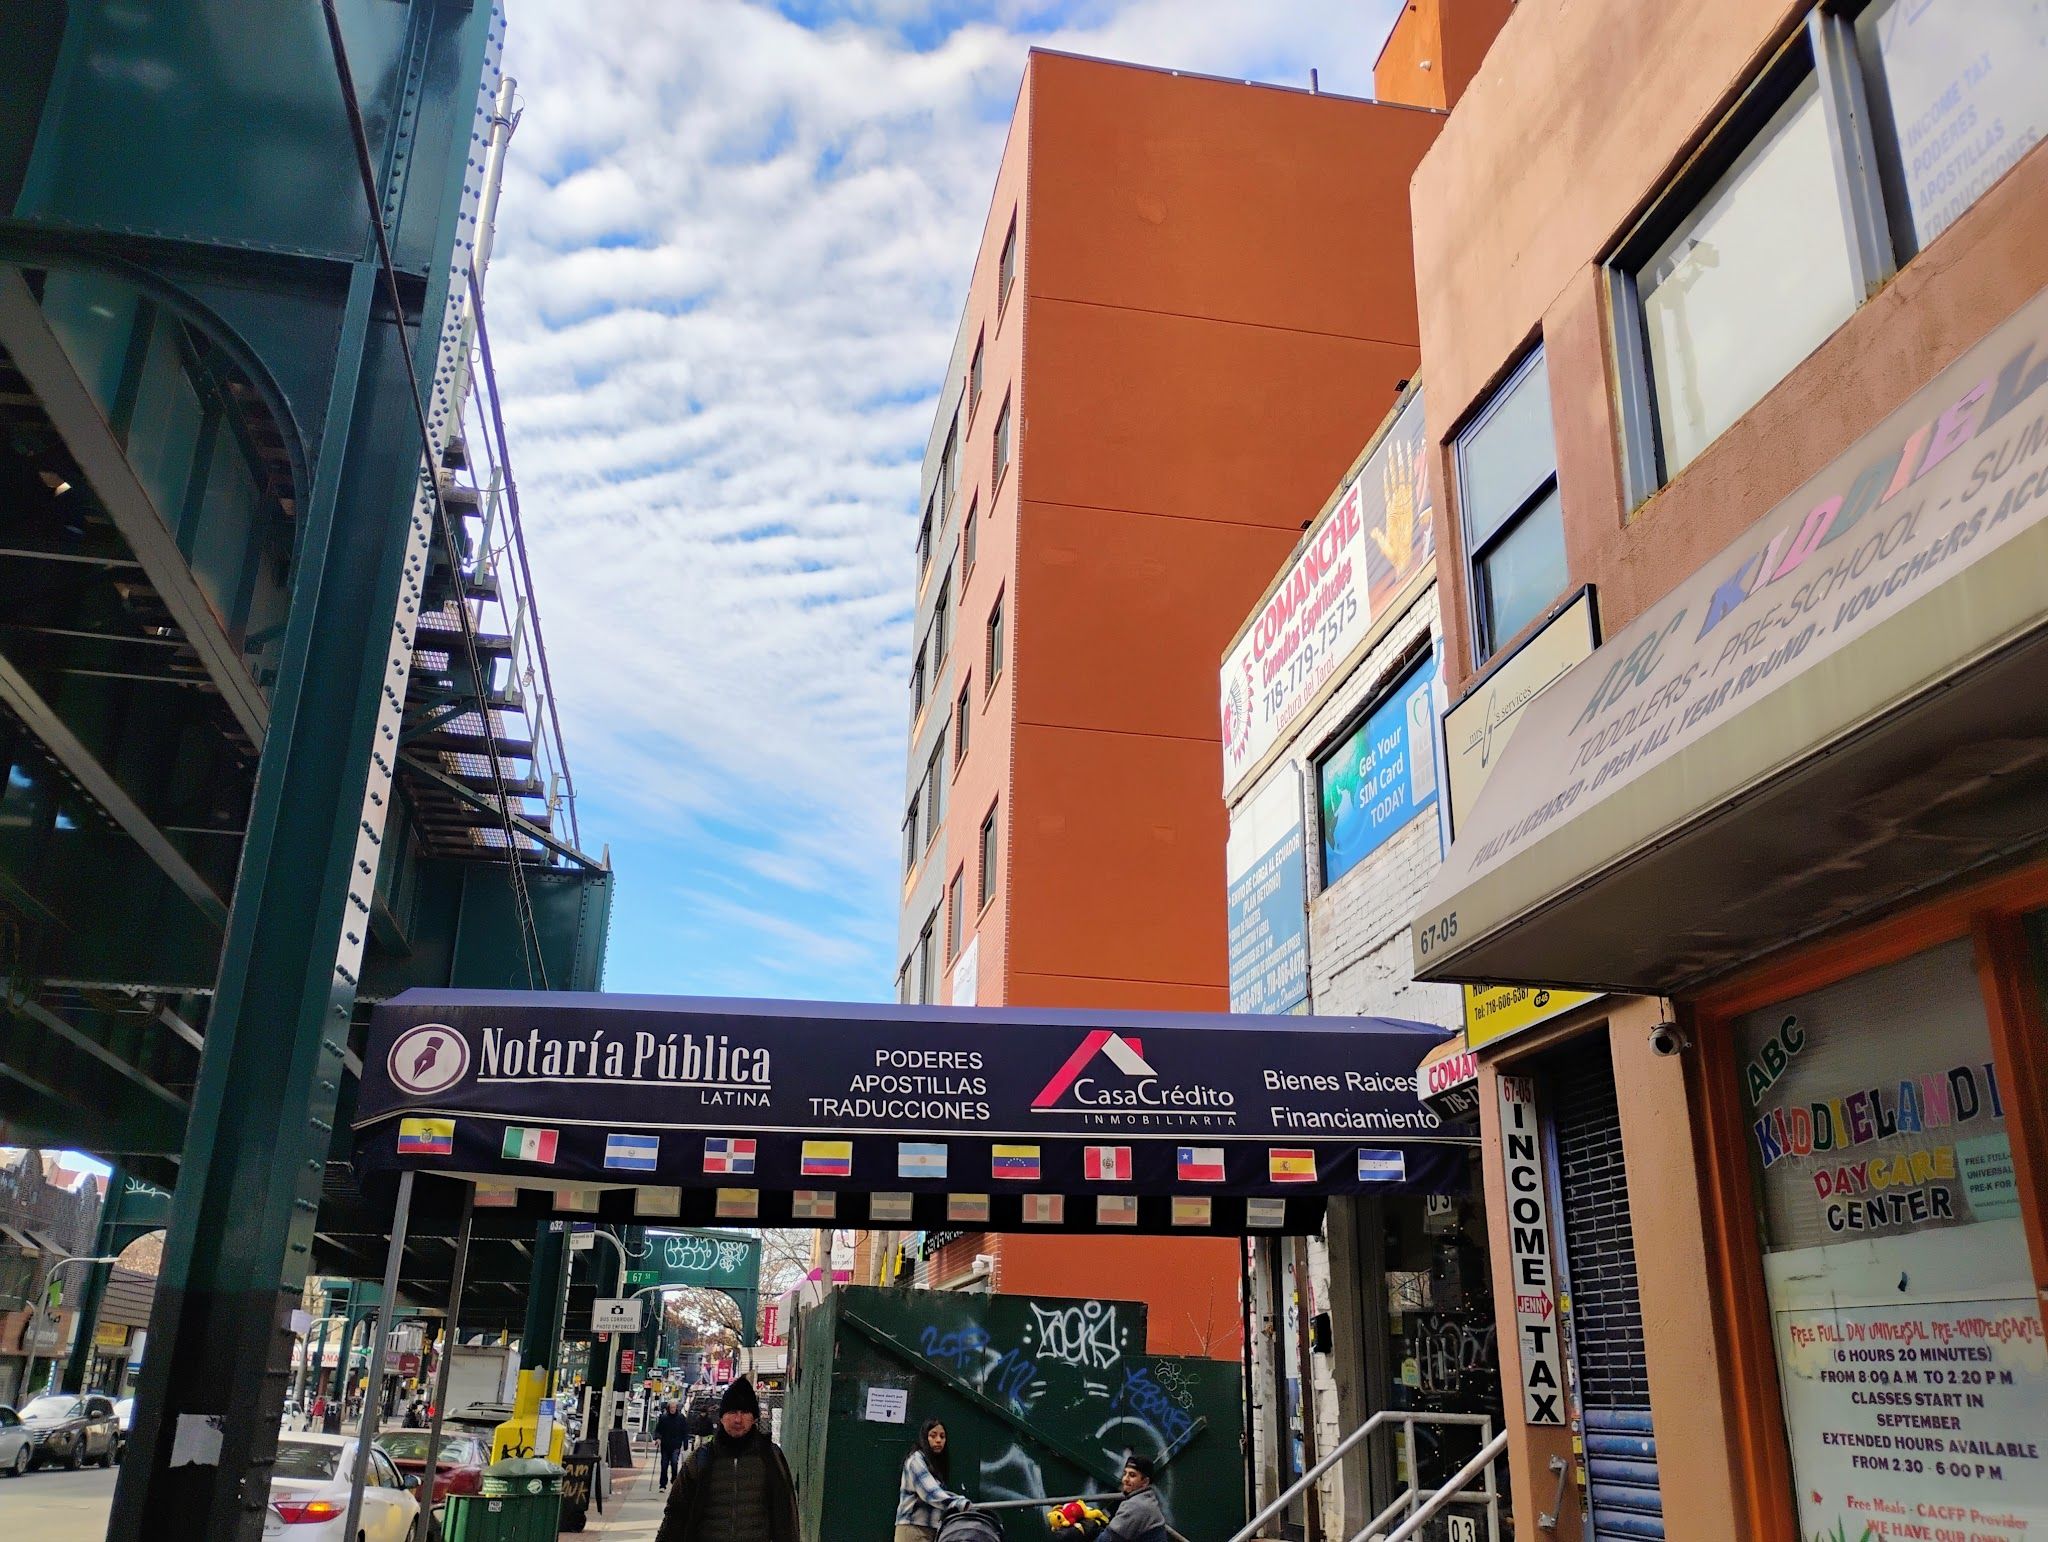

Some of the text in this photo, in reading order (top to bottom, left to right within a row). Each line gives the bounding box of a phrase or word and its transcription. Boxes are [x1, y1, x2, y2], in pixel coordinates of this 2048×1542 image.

[1907, 54, 1992, 149] INCOME TAX
[1913, 103, 1977, 179] PODERES
[1919, 117, 2006, 212] APOSTILLAS
[1253, 486, 1360, 663] COMANCHE
[1569, 663, 1699, 775] TODDLERS
[1711, 500, 1925, 677] PRE-SCHOOL
[1263, 587, 1357, 723] 718-779-7575
[1304, 676, 1314, 702] del
[1315, 651, 1335, 692] Tarot
[1568, 608, 1688, 736] ABC
[1468, 824, 1516, 872] FULLY
[1509, 778, 1585, 845] LICENSED
[1590, 738, 1643, 791] OPEN
[1636, 718, 1675, 762] ALL
[1676, 678, 1735, 735] YEAR
[1730, 624, 1816, 699] ROUND
[1833, 507, 1987, 633] VOUCHERS
[1501, 686, 1532, 716] services
[1360, 725, 1401, 778] Get Your
[1359, 752, 1403, 808] SIM Card
[1371, 783, 1405, 828] TODAY
[1275, 832, 1300, 868] ECUADOR
[1420, 911, 1458, 955] 67-05
[479, 1026, 771, 1084] Notaría Pública
[875, 1049, 983, 1071] PODERES
[1746, 1014, 1806, 1106] ABC
[850, 1074, 987, 1096] APOSTILLAS
[1264, 1070, 1418, 1093] Bienes Raices
[1504, 1077, 1531, 1103] 67-05
[701, 1090, 770, 1107] LATINA
[809, 1098, 990, 1122] TRADUCCIONES
[1084, 1113, 1238, 1128] INMOBILIARIA
[1271, 1106, 1440, 1130] Financiamiento
[1753, 1065, 1981, 1168] KIDDIELAND
[1965, 1155, 1985, 1165] FREE
[1967, 1166, 2013, 1179] UNIVERSAL
[1507, 1103, 1546, 1286] INCOME
[1970, 1180, 2011, 1193] PRE-K FOR
[1827, 1186, 1953, 1232] CENTER
[632, 1273, 642, 1282] 67
[1519, 1296, 1548, 1314] JENNY
[1790, 1325, 1815, 1348] FREE
[1817, 1324, 1845, 1342] FULL
[1846, 1322, 1866, 1342] DAY
[1869, 1320, 1929, 1345] UNIVERSAL
[1849, 1350, 1895, 1362] HOURS
[1899, 1350, 1917, 1362] 20
[1920, 1346, 1993, 1363] MINUTES)
[1525, 1325, 1559, 1424] TAX
[1820, 1370, 1855, 1383] FROM
[1925, 1371, 1943, 1384] TO
[1851, 1391, 1985, 1408] CLASSES START IN
[1876, 1414, 1961, 1430] SEPTEMBER
[1822, 1432, 2039, 1459] EXTENDED HOURS AVAILABLE
[1852, 1455, 1889, 1471] FROM
[1846, 1495, 2029, 1529] Free Meals CACFP Provider
[1866, 1519, 1889, 1535] WE
[1892, 1522, 1932, 1541] HAVE
